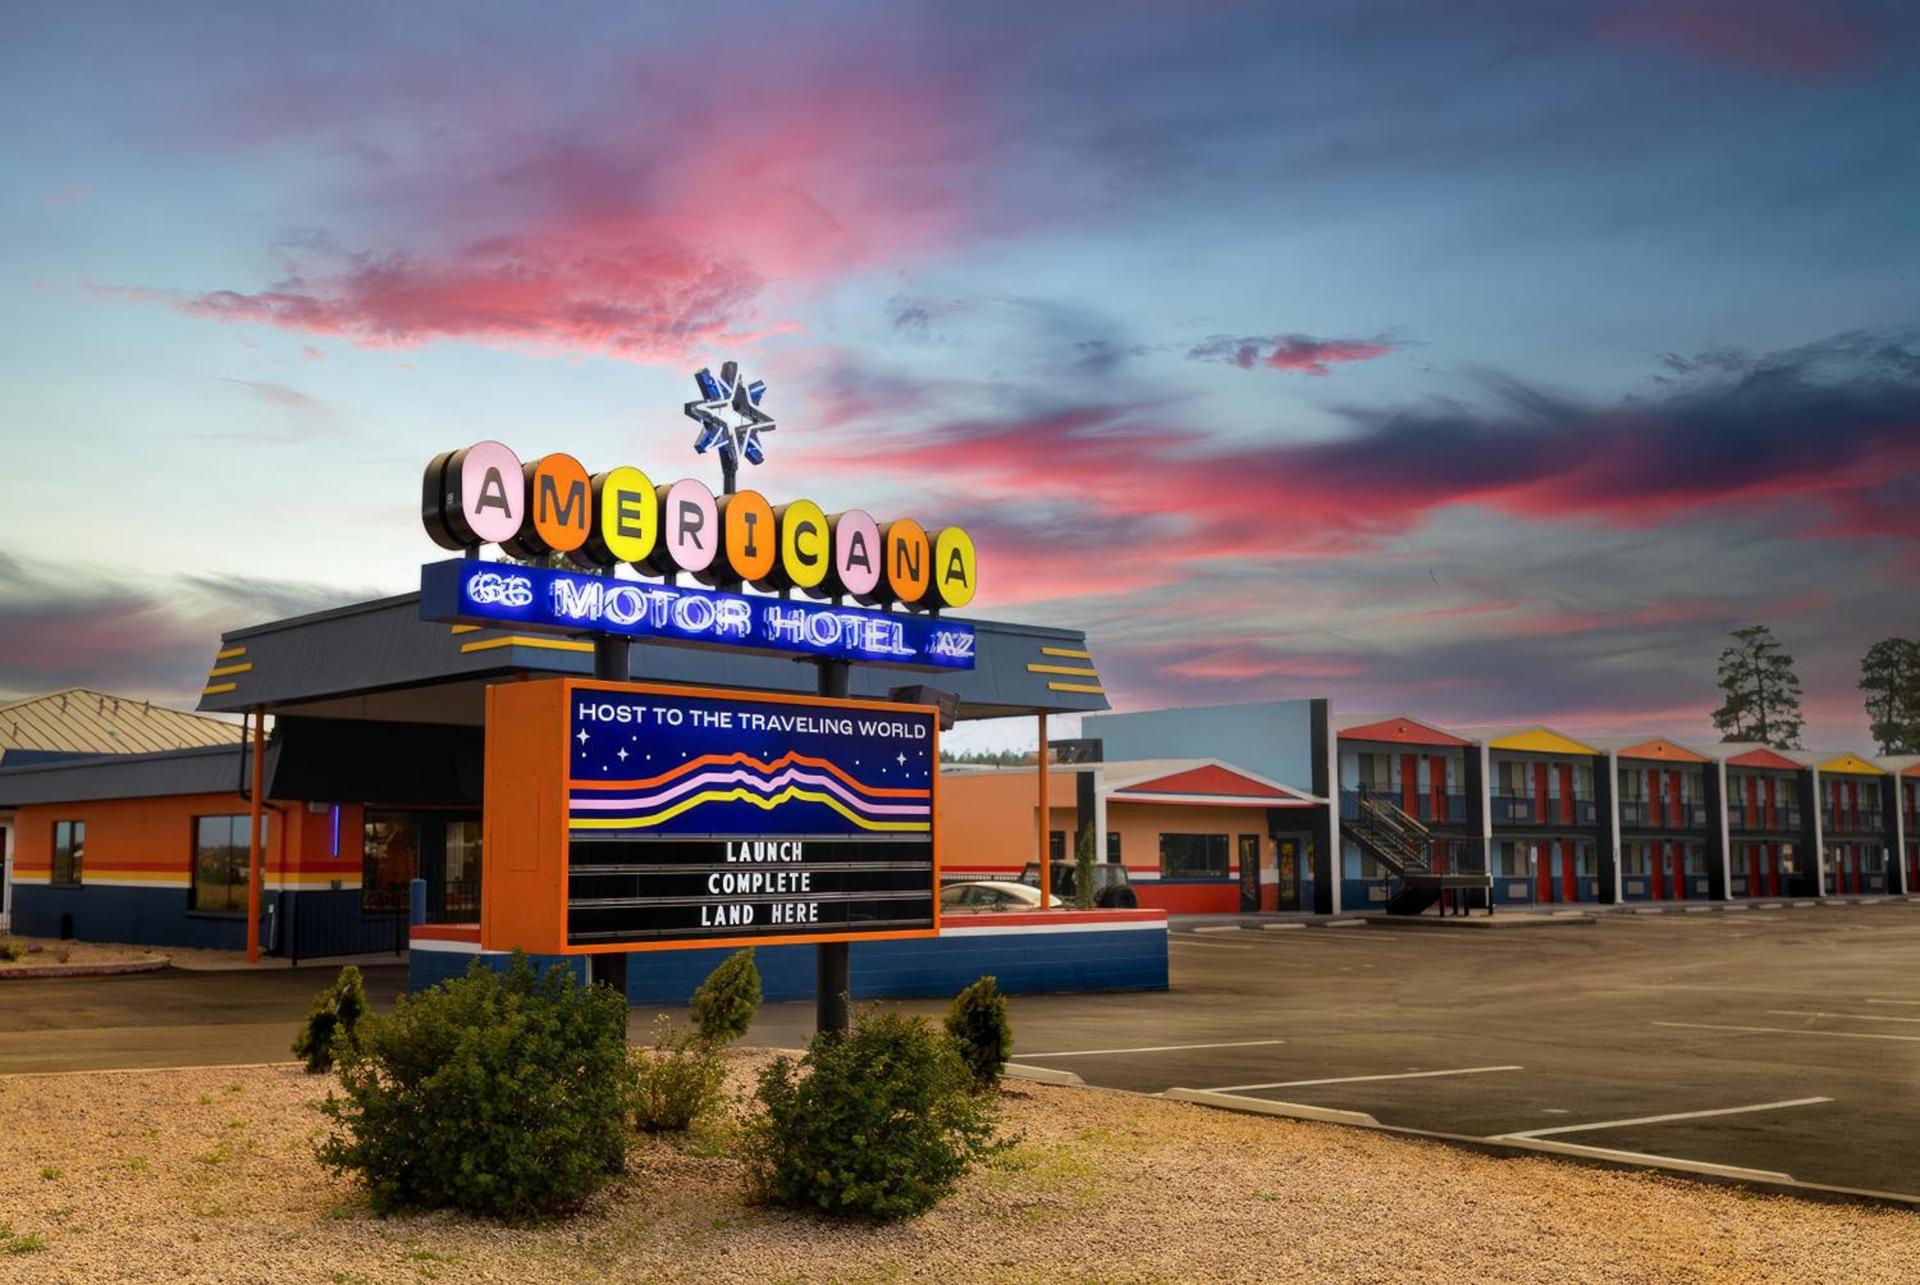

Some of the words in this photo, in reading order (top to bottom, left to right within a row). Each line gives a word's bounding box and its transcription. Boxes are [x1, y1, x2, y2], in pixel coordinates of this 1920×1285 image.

[474, 466, 969, 590] AMERICANA
[467, 571, 533, 607] 66
[550, 578, 751, 638] MOTOR
[763, 605, 917, 656] HOTEL
[929, 630, 974, 657] AZ
[578, 702, 647, 724] HOST
[652, 707, 684, 726] TO
[689, 709, 733, 729] THE
[738, 712, 853, 736] TRAVELING
[858, 720, 927, 740] WORLD
[726, 841, 803, 862] LAUNCH
[707, 872, 811, 894] COMPLETE
[701, 904, 754, 927] LAND
[771, 903, 819, 924] HERE
